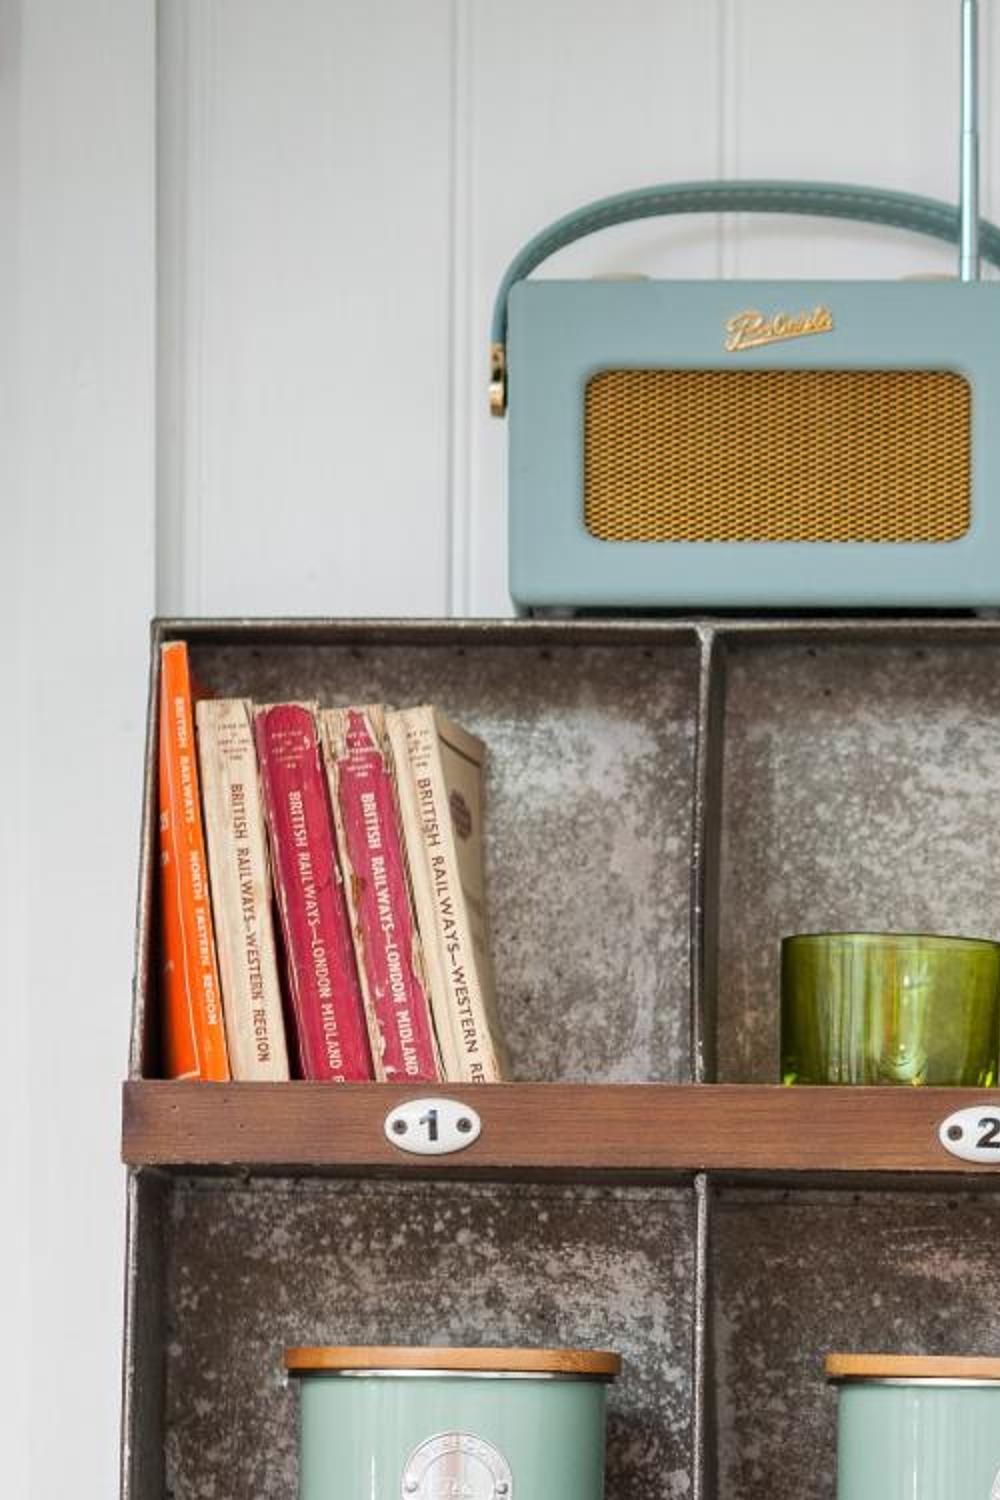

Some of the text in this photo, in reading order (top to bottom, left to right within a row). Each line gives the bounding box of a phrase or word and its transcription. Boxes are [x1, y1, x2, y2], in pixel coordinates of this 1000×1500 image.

[175, 696, 188, 749] BRITISH
[417, 777, 441, 847] BRITISH
[190, 851, 202, 900] NORTH
[195, 907, 211, 966] EASTERN
[230, 783, 250, 839] BRITISH
[252, 1009, 272, 1063] REGION
[288, 791, 308, 848] BRITISH
[321, 1003, 344, 1070] MIDLAND
[361, 792, 382, 849] BRITISH
[396, 1009, 420, 1076] MIDLAND
[203, 973, 217, 1026] REGION
[418, 1110, 438, 1142] 1
[975, 1118, 1000, 1149] 2
